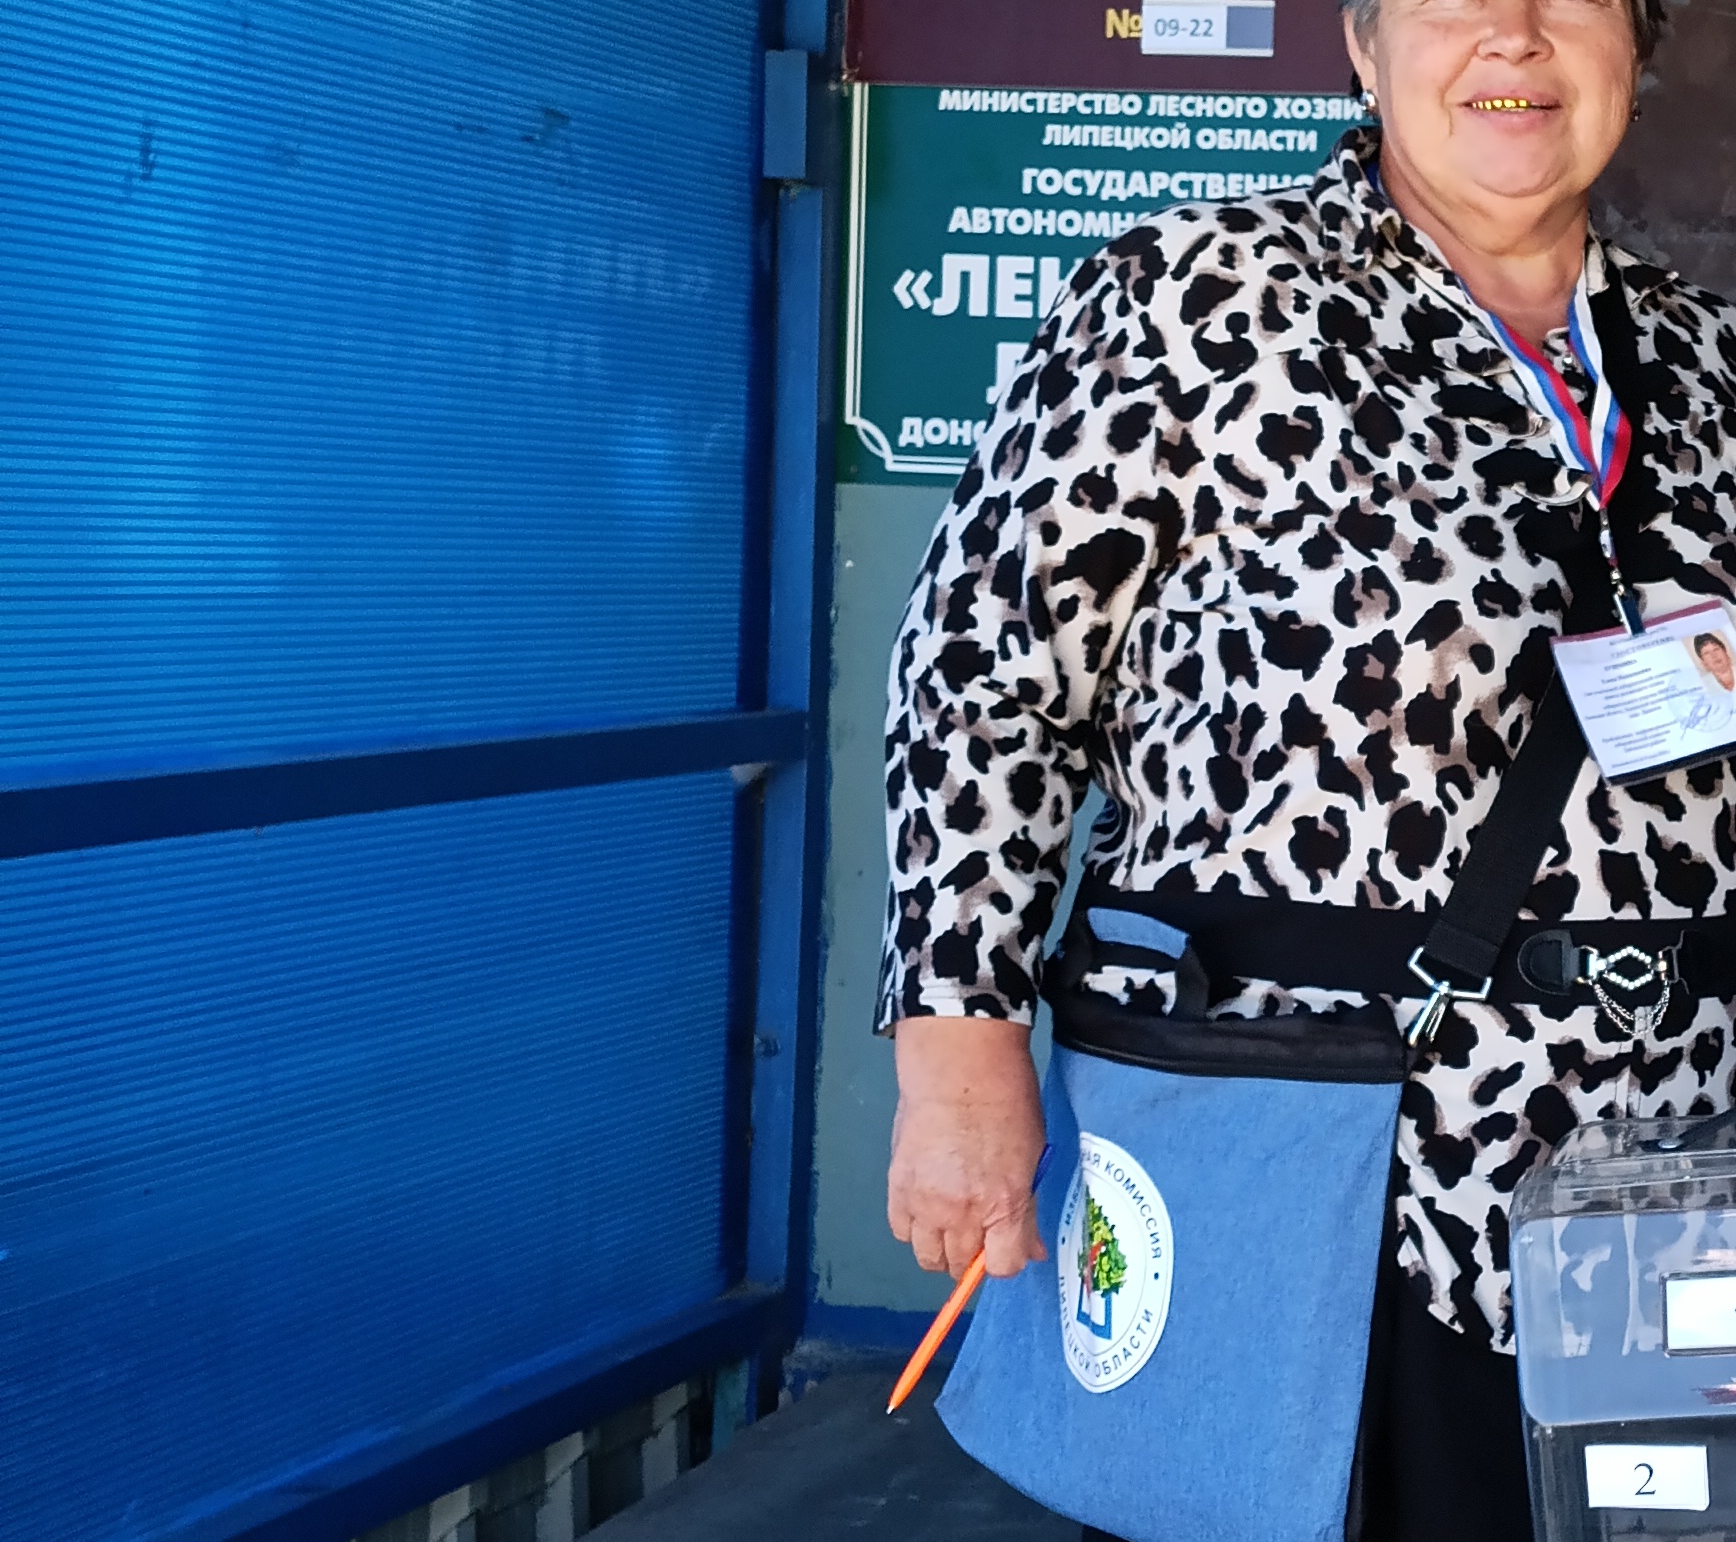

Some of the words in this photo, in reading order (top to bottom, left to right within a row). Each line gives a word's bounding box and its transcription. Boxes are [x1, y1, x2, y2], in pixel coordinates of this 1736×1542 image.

[1105, 8, 1142, 39] №
[1154, 18, 1214, 37] 09-22
[938, 90, 1143, 116] МИНИСТЕРСТВО
[1147, 95, 1266, 119] ЛЕСНОГО
[1043, 123, 1190, 151] ЛИПЕЦКОЙ
[1196, 128, 1318, 152] ОБЛАСТИ
[948, 206, 1151, 239] АВТОНОМН
[1104, 1160, 1162, 1259] КОМИССИЯ
[1094, 1308, 1153, 1378] ОБЛАСТИ
[1633, 1462, 1656, 1496] 2
